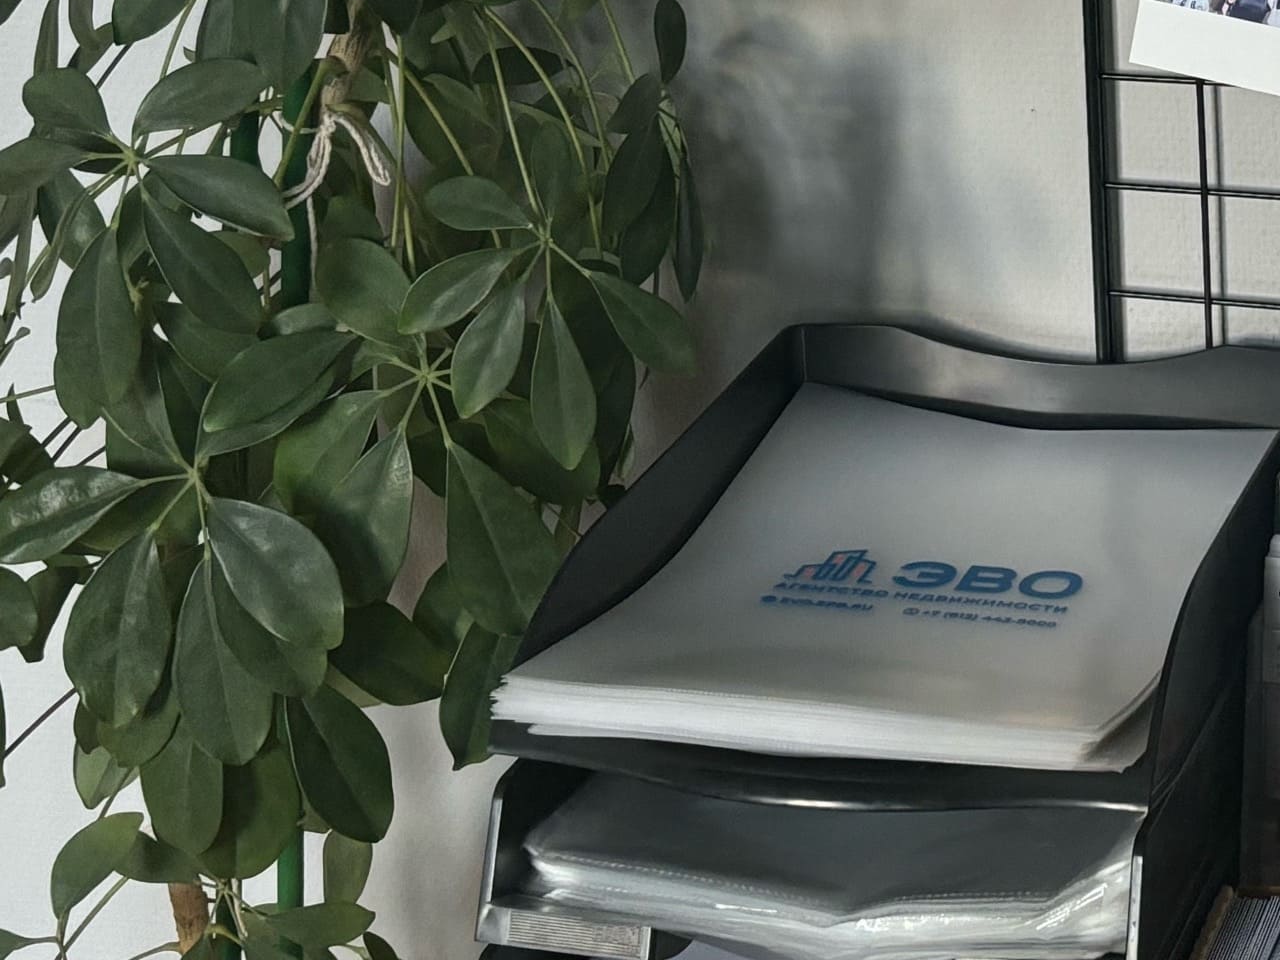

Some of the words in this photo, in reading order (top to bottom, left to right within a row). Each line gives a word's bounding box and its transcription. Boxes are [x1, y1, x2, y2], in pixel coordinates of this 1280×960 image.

[775, 581, 889, 598] АГЕНТСТВО
[894, 590, 1069, 614] НЕДВИЖИМОСТИ
[892, 561, 1083, 600] ЭВО
